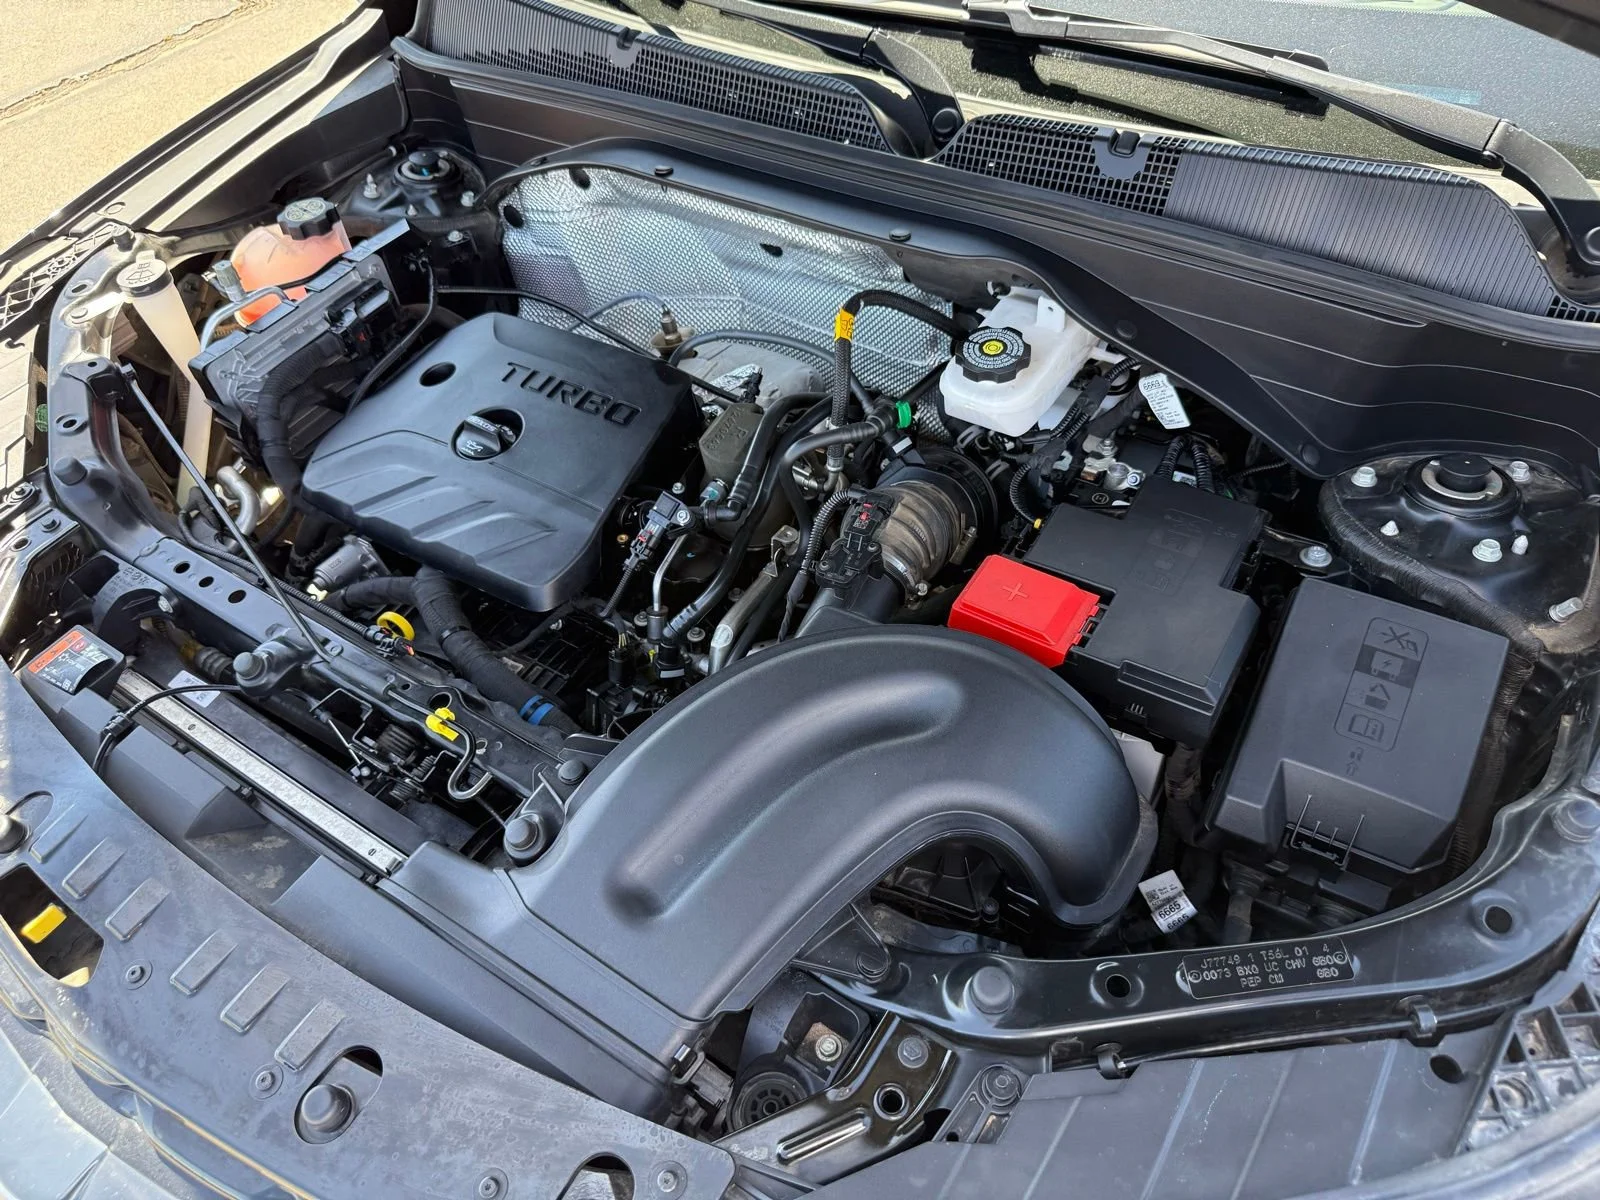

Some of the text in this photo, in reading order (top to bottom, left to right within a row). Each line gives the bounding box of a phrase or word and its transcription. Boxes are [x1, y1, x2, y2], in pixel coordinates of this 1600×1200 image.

[501, 361, 642, 426] TURBO
[1158, 900, 1181, 919] 6665
[1200, 954, 1241, 969] J77749
[1202, 966, 1231, 981] 0073
[1264, 961, 1280, 972] UC
[1240, 976, 1261, 988] PEP
